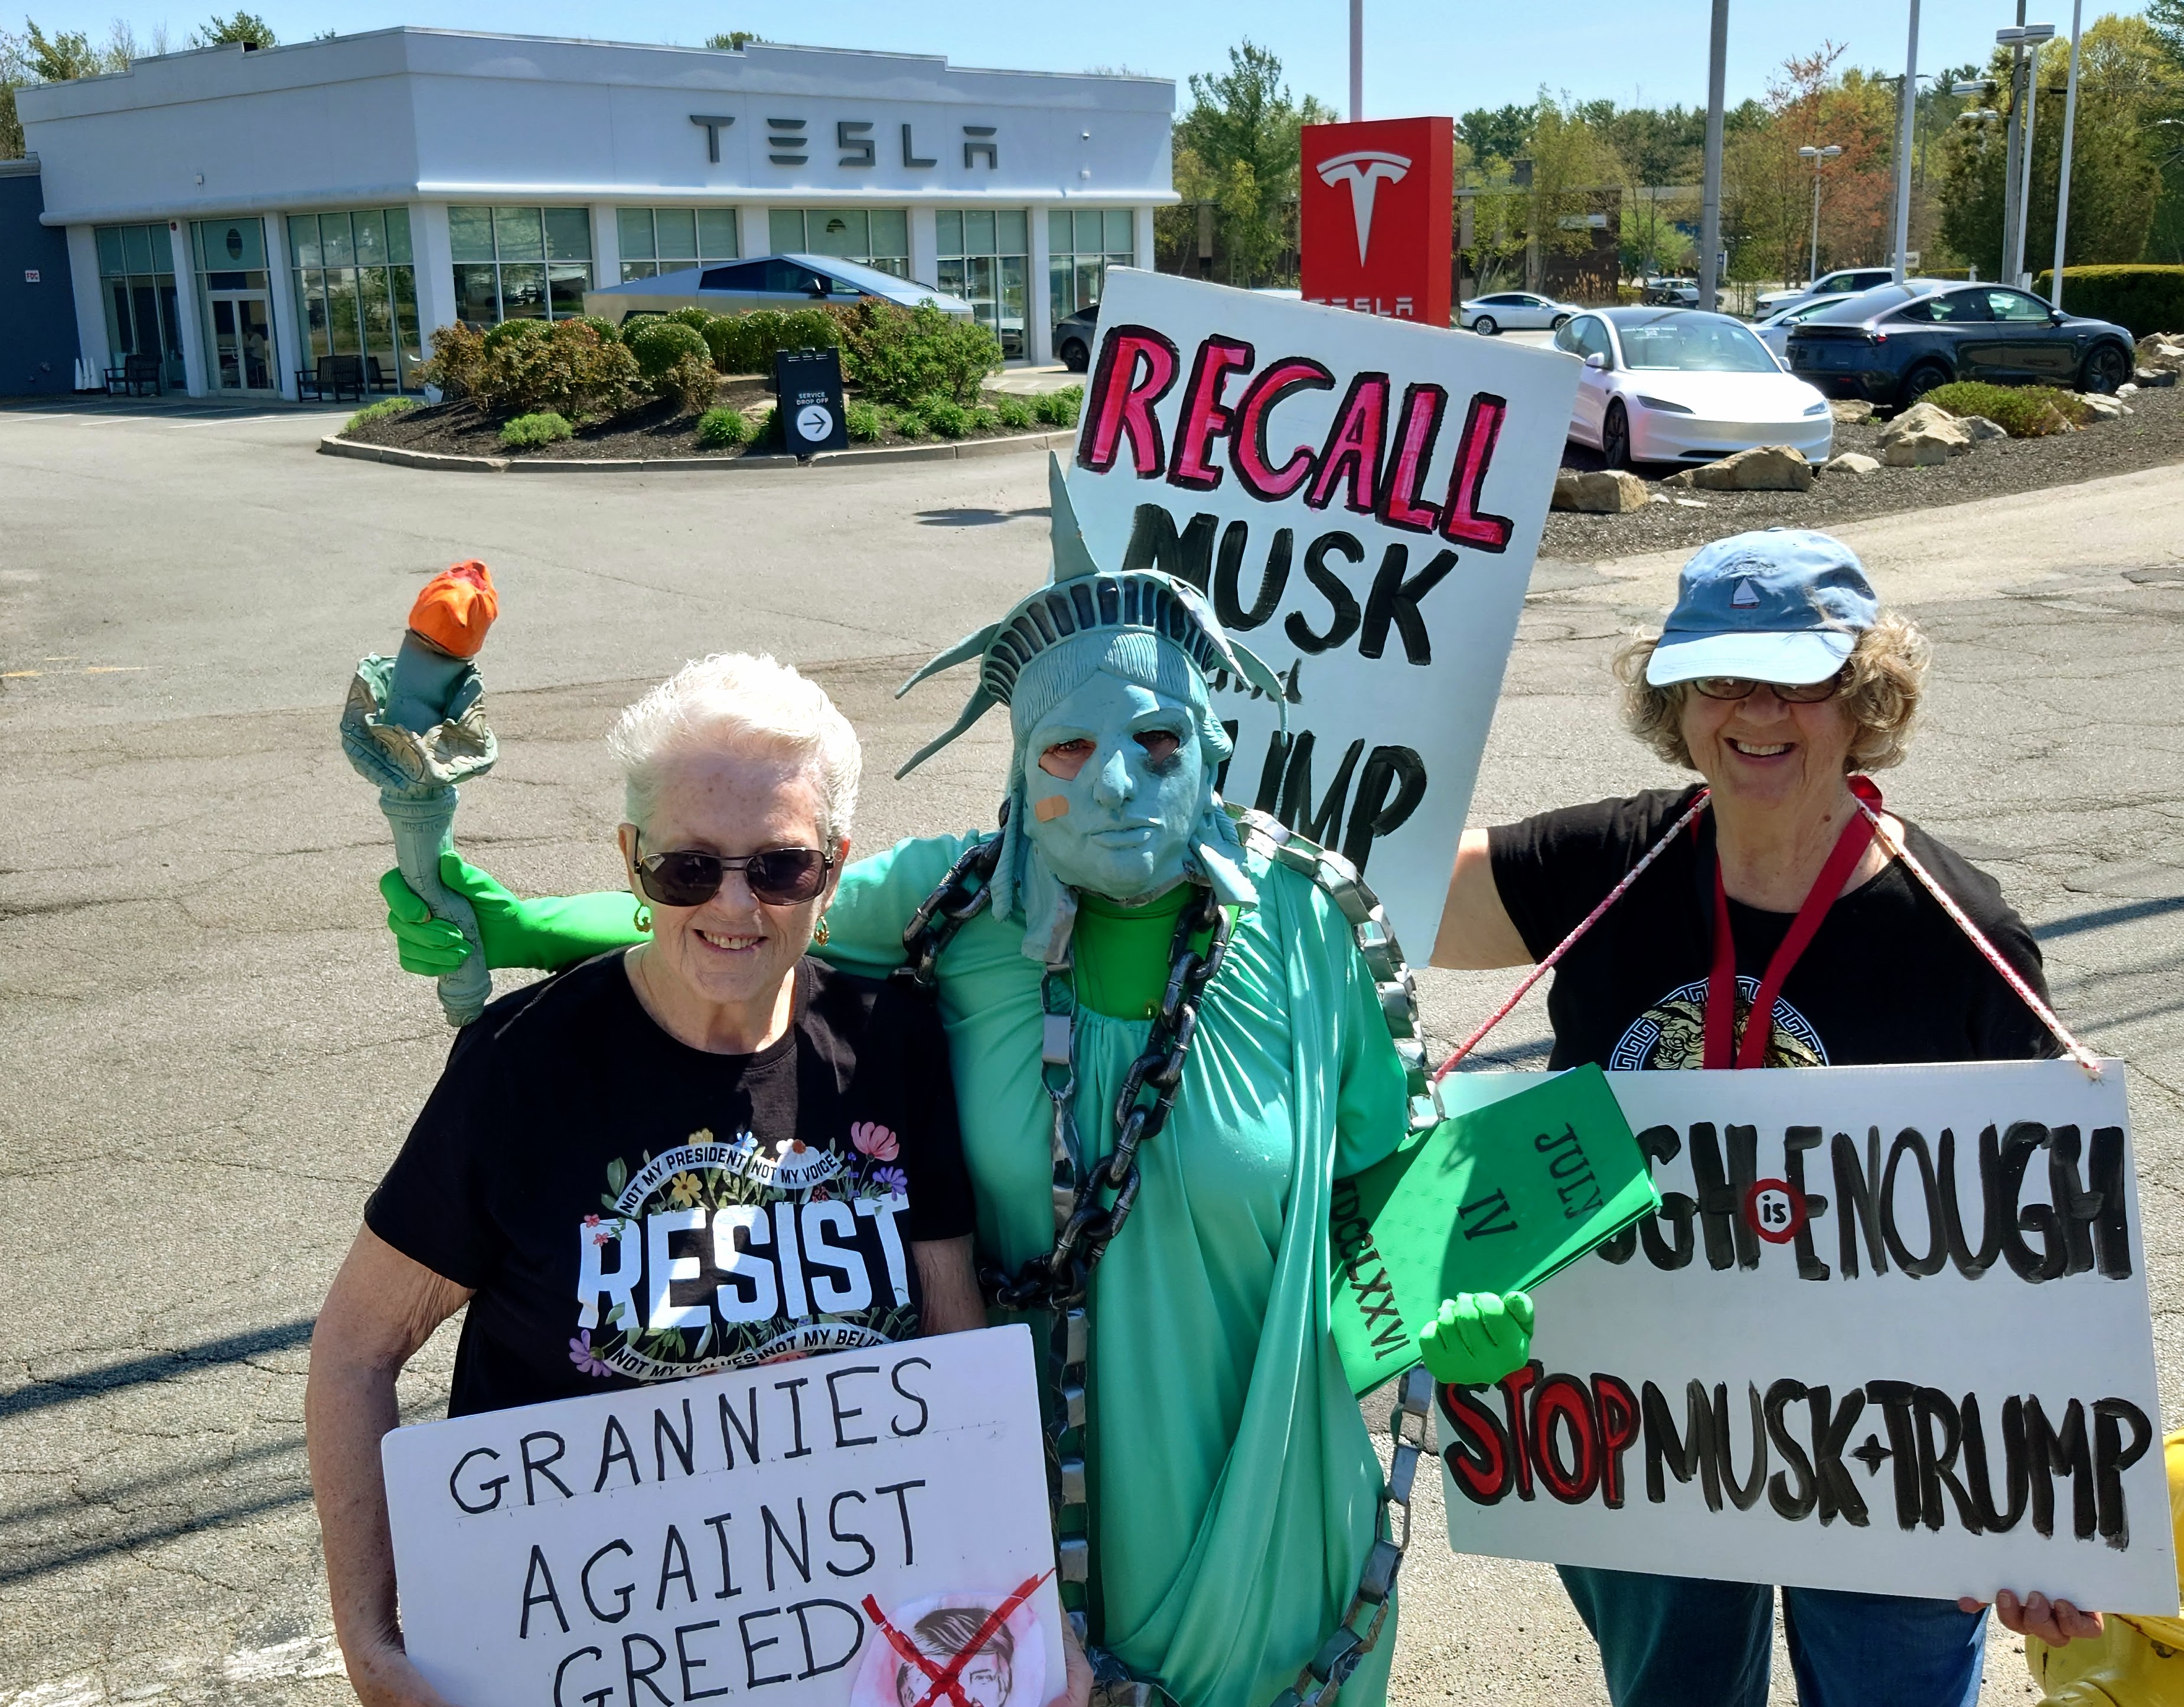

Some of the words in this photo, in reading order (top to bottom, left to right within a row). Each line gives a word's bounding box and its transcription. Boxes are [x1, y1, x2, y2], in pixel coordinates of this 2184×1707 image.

[689, 115, 998, 170] TESLA
[1077, 324, 1514, 554] RECALL
[1121, 503, 1459, 666] MUSK
[619, 1183, 644, 1214] NOT
[641, 1161, 663, 1187] MY
[666, 1146, 747, 1170] PRESIDENT
[751, 1159, 778, 1181] NOT
[781, 1169, 799, 1184] MY
[801, 1153, 838, 1182] VOICE
[1456, 1188, 1518, 1241] IV
[1534, 1122, 1603, 1219] JULY
[1762, 1194, 1786, 1224] is
[1783, 1121, 2134, 1284] ENOUGH
[578, 1192, 910, 1331] RESIST
[611, 1348, 650, 1375] NOT
[649, 1365, 680, 1377] MY
[763, 1335, 797, 1358] NOT
[804, 1329, 831, 1347] MY
[449, 1357, 932, 1515] GRANNIES
[1436, 1359, 1642, 1509] STOP
[520, 1479, 926, 1639] AGAINST
[553, 1598, 865, 1707] GREED
